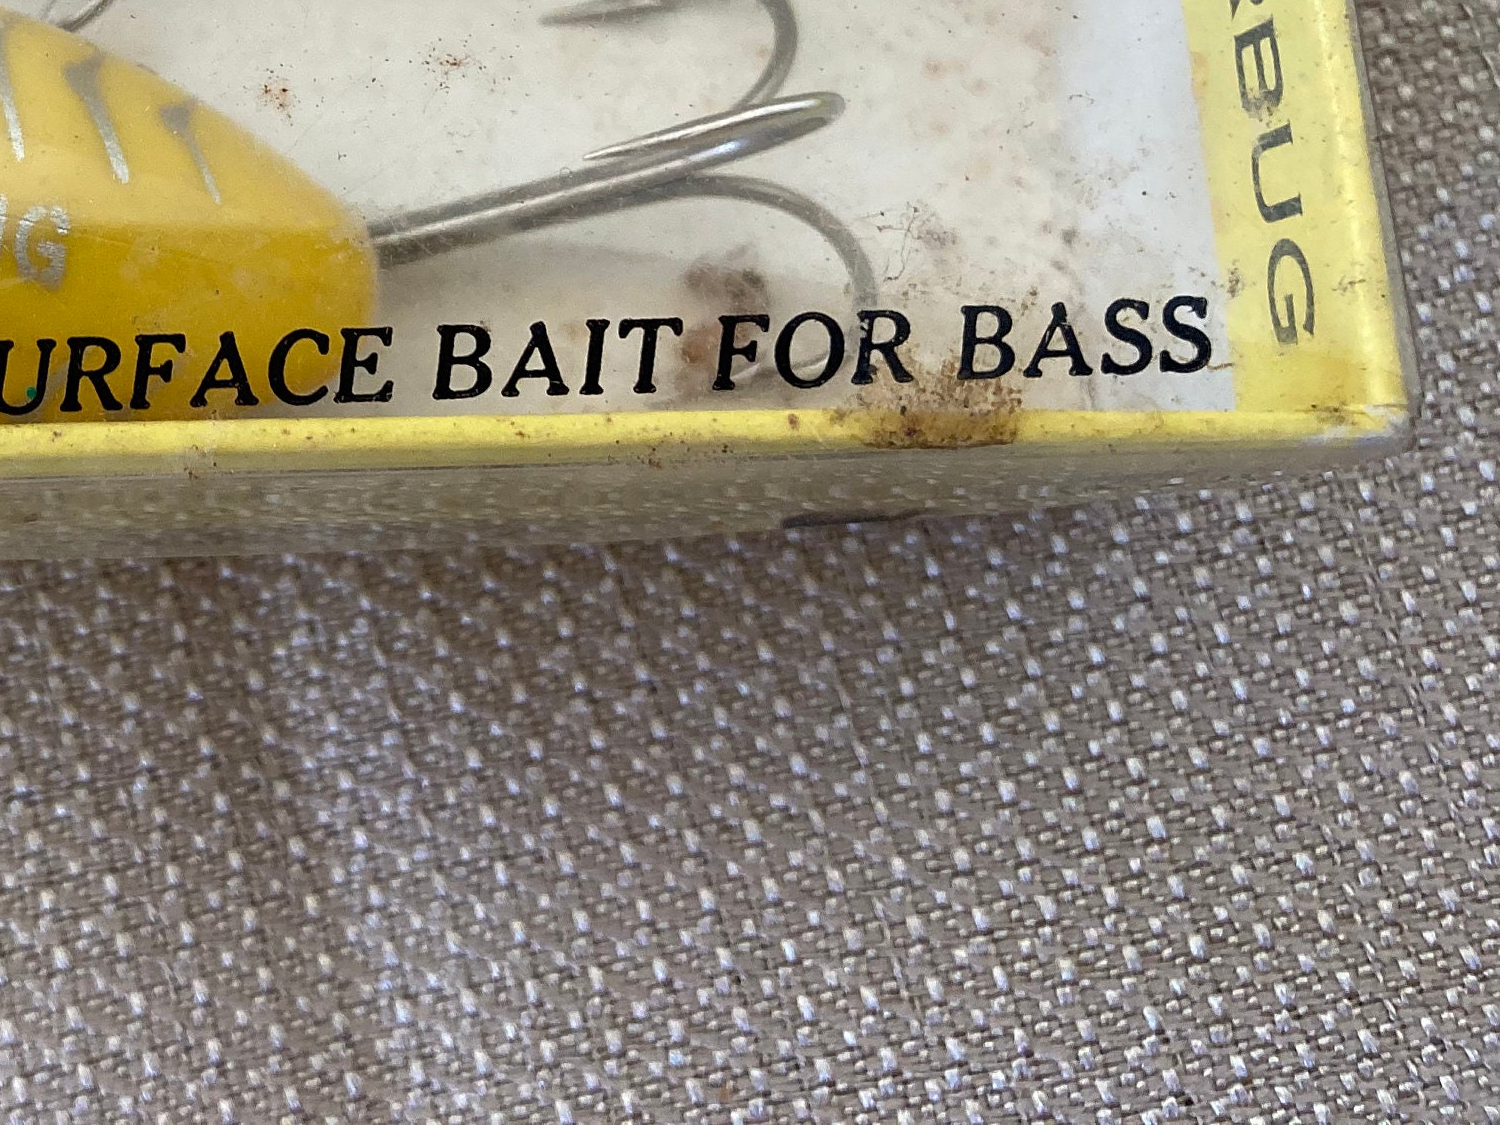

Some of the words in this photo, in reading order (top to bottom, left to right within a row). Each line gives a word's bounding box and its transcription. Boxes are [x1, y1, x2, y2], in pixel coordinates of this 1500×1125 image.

[432, 316, 683, 400] BAIT
[712, 309, 914, 391] FOR
[956, 295, 1214, 380] BASS
